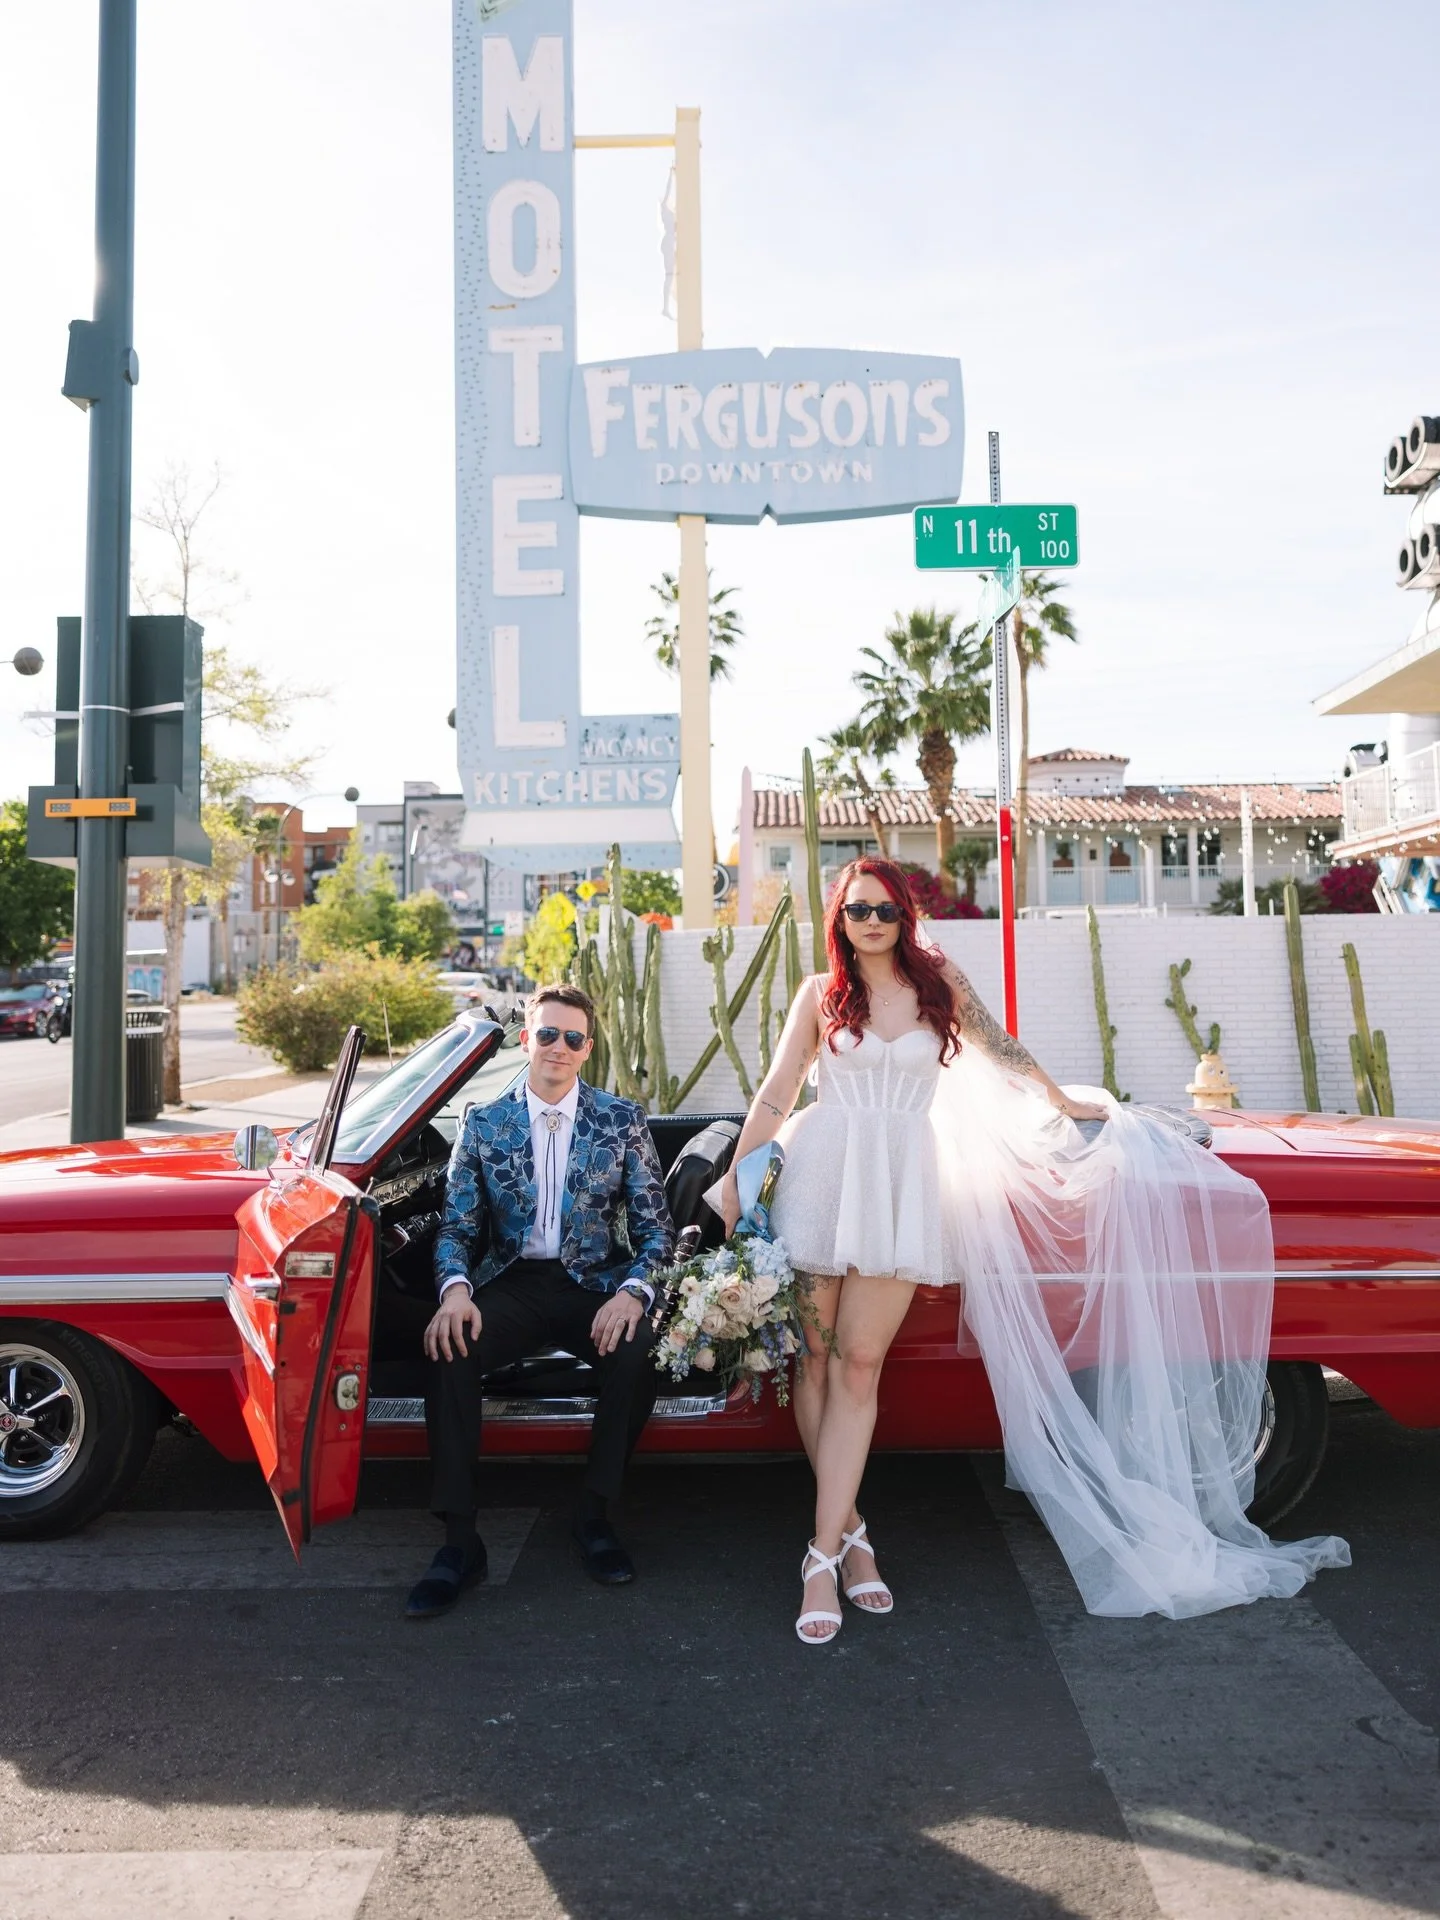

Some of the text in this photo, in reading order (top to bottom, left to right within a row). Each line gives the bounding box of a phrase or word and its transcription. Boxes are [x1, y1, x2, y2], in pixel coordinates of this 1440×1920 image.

[482, 34, 566, 749] MOTEL
[656, 461, 873, 484] DOWNTOWN
[922, 515, 933, 533] N
[1038, 513, 1059, 531] ST
[1040, 540, 1070, 559] 100
[584, 736, 678, 757] VACANCY
[473, 768, 668, 804] KITCHENS
